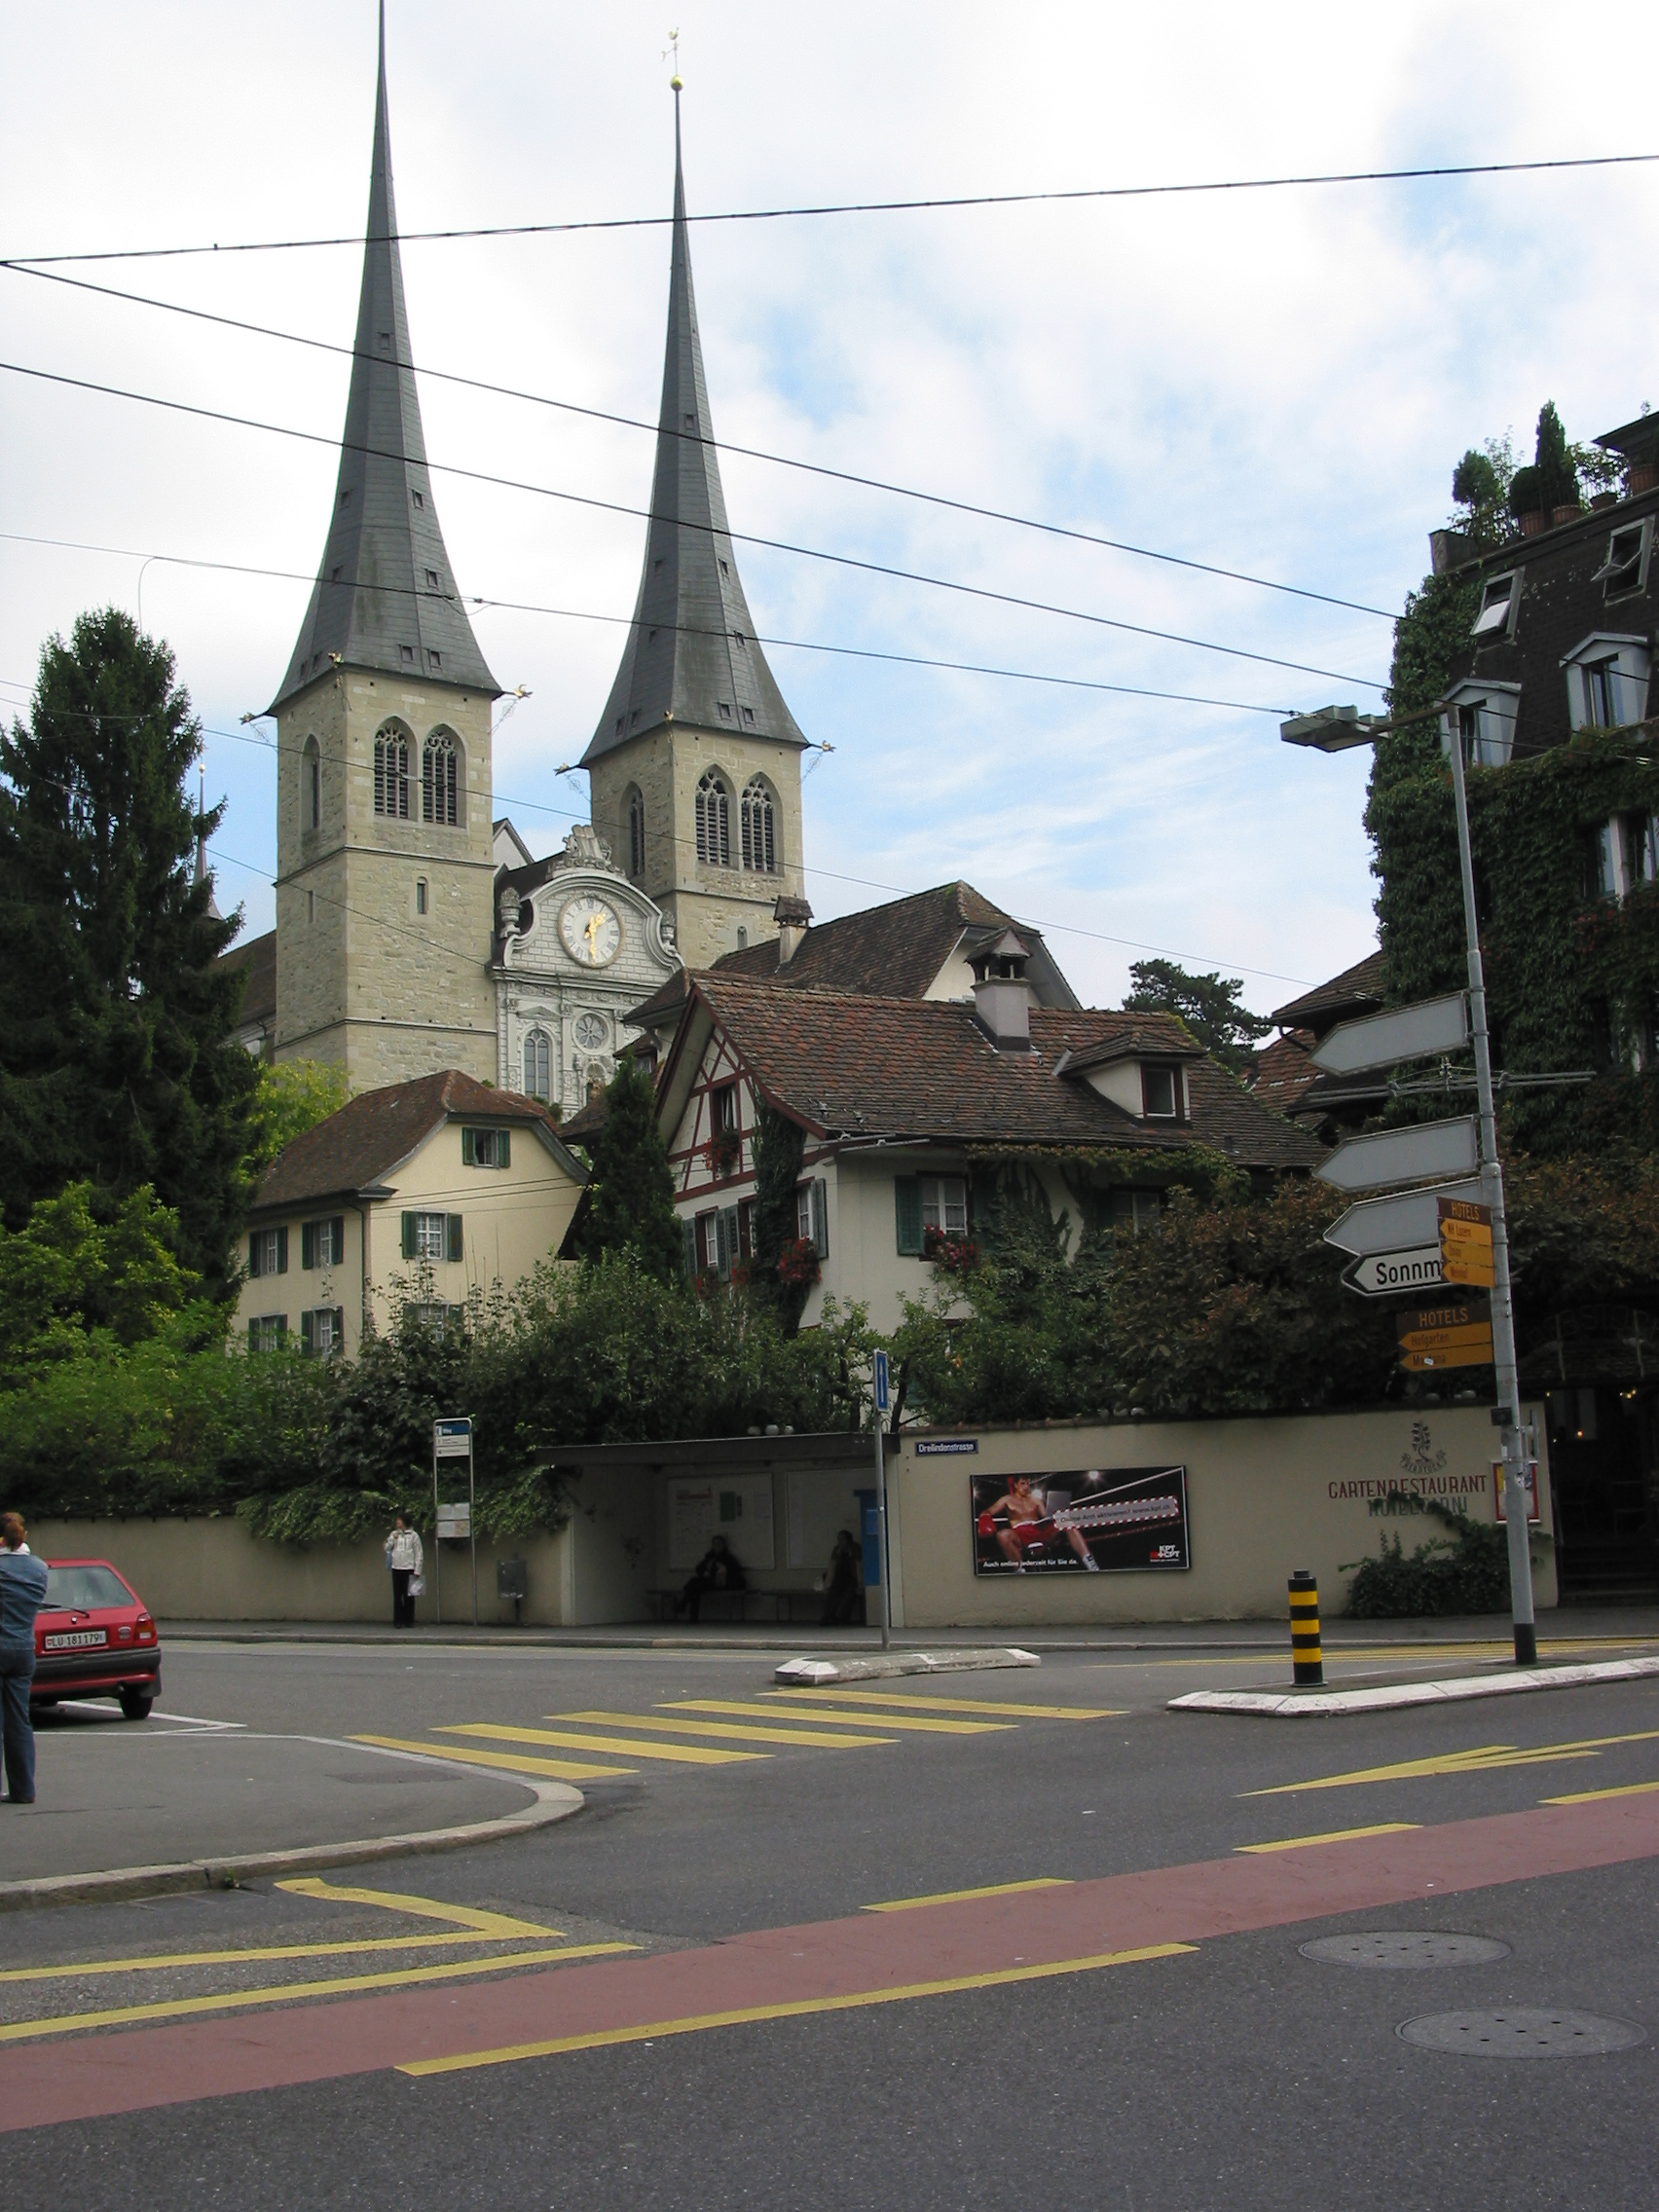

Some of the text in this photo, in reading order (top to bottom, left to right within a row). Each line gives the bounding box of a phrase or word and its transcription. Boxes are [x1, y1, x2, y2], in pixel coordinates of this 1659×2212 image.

[1451, 1202, 1479, 1220] HOTELS
[1419, 1307, 1468, 1327] HOTELS
[52, 1637, 64, 1647] LU
